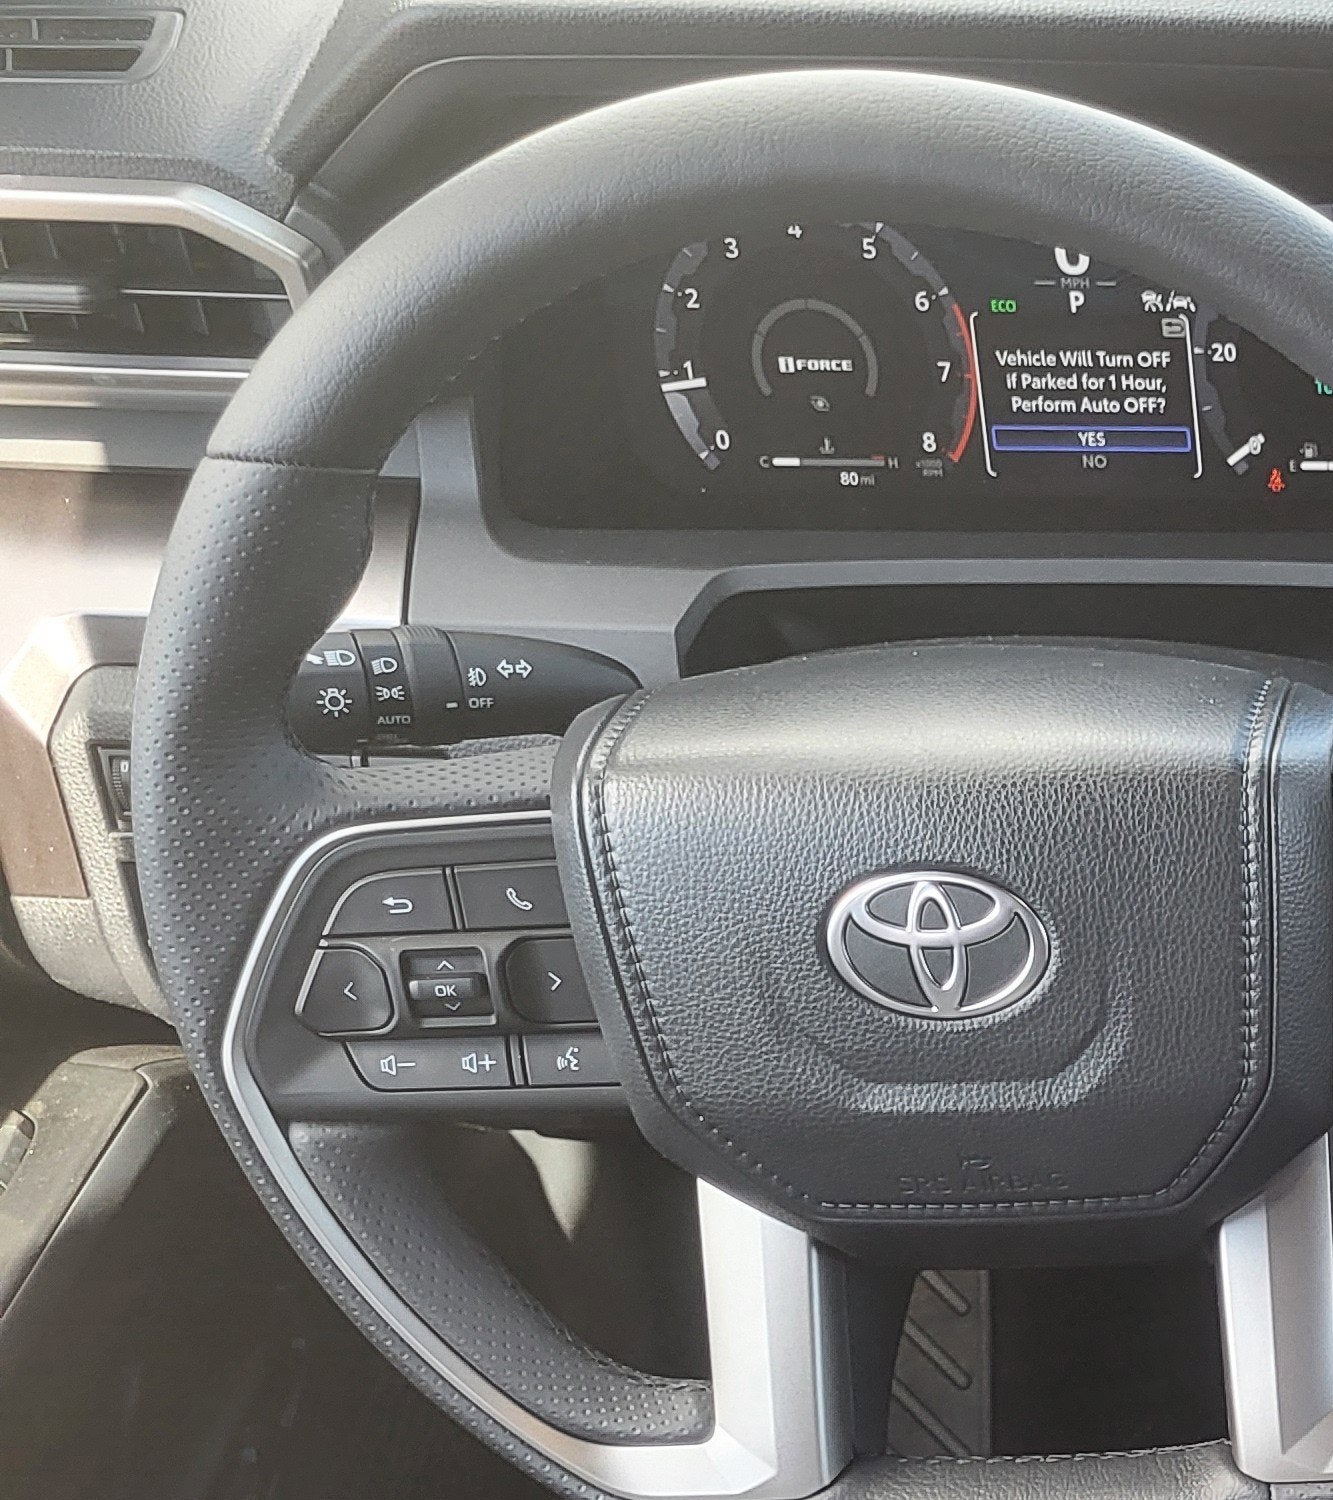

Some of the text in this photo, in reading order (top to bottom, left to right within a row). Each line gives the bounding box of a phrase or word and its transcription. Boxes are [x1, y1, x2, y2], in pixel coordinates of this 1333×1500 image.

[787, 225, 802, 239] 4
[724, 238, 739, 259] 3
[862, 238, 877, 259] 5
[1060, 277, 1090, 288] MPH
[685, 289, 700, 308] 2
[914, 291, 930, 312] 6
[990, 300, 1017, 313] ECO
[1069, 290, 1085, 313] P
[995, 349, 1171, 368] Vehicle Will Turn OFF
[1211, 343, 1237, 362] 20
[683, 361, 695, 379] 1
[937, 361, 951, 382] 7
[1021, 372, 1167, 394] Parked for 1 Hour,
[1011, 395, 1167, 414] Perform Auto OFF?
[715, 430, 730, 450] 0
[922, 432, 937, 452] 8
[1077, 431, 1106, 447] YES
[759, 456, 770, 468] C
[887, 457, 899, 469] H
[1082, 454, 1107, 469] NO
[860, 473, 875, 486] mi
[468, 697, 495, 709] OFF
[377, 714, 411, 725] AUTO
[434, 985, 457, 998] OK
